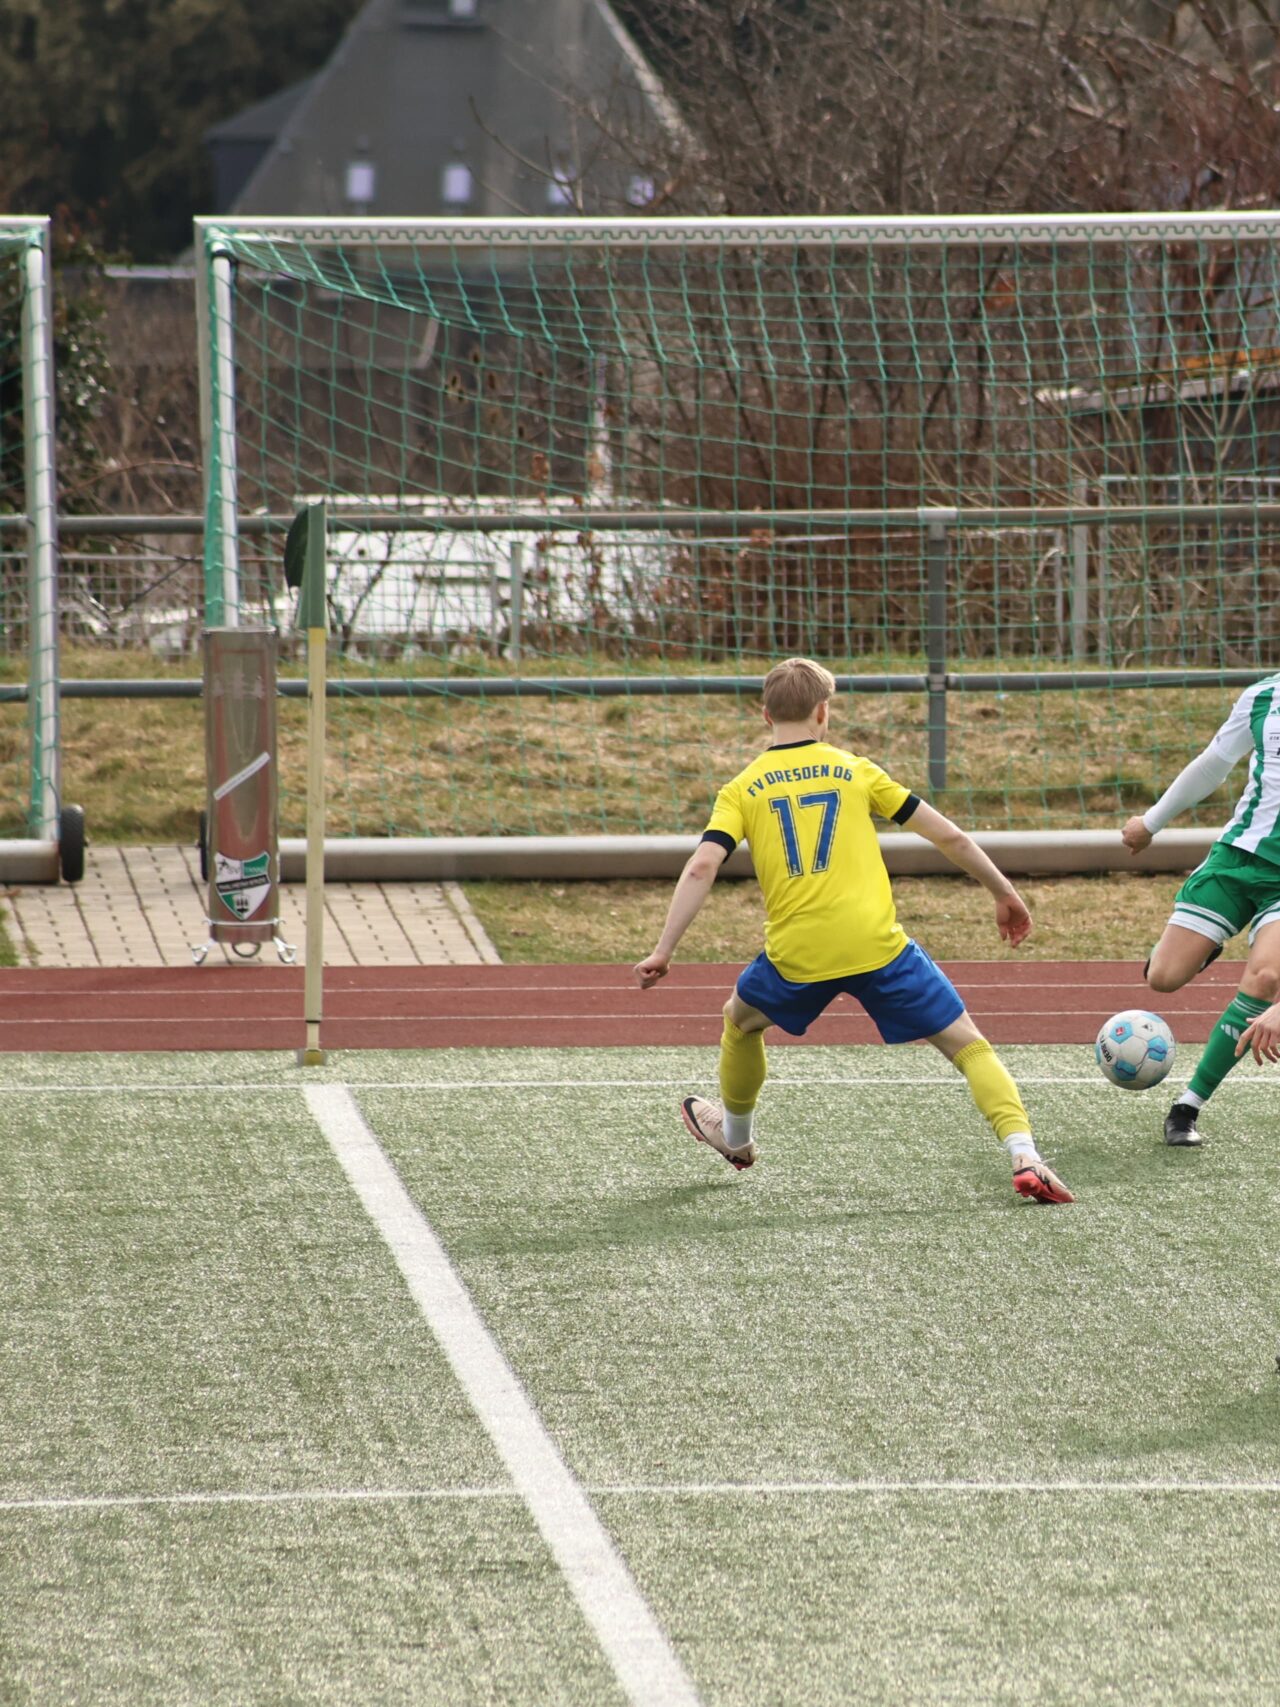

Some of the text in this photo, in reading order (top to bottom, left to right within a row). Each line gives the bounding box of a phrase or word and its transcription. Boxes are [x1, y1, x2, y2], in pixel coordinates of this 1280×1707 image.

[747, 765, 853, 797] FV DRESDEN 06
[768, 789, 841, 878] 17
